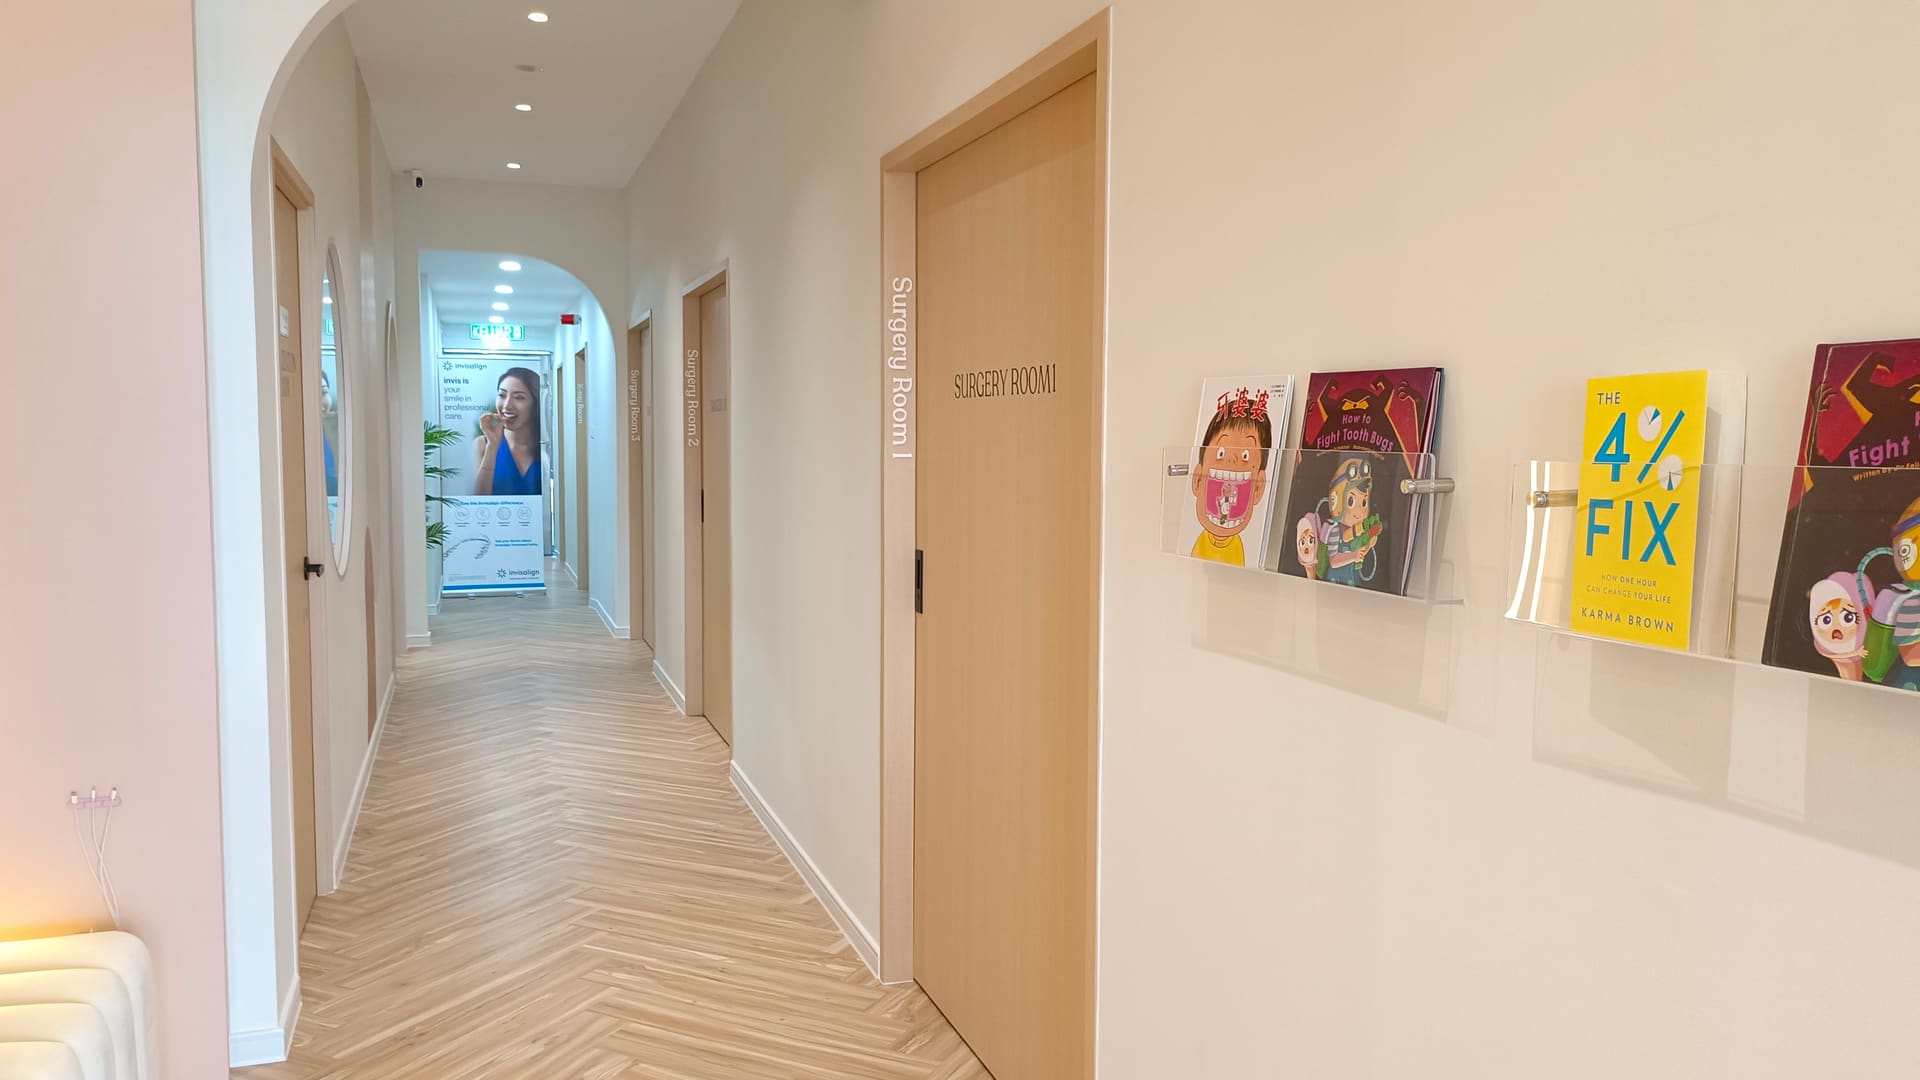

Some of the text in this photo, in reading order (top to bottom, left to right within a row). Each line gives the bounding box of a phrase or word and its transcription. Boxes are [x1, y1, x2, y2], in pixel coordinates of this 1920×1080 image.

[887, 277, 913, 370] Surgery
[454, 362, 488, 370] invisalign
[443, 376, 470, 385] invis is
[629, 369, 640, 406] Surgery
[954, 368, 1008, 399] SURGERY
[685, 349, 699, 447] Surgery Room 2
[1215, 385, 1270, 423] 牙婆婆
[1597, 391, 1621, 405] THE
[631, 407, 641, 433] Room
[892, 377, 913, 446] Room
[1342, 413, 1372, 425] How to
[1316, 429, 1341, 450] Fight
[1343, 428, 1369, 443] Tooth
[1369, 431, 1394, 452] Bugs
[1593, 406, 1686, 490] 4%
[1848, 435, 1911, 469] Fight
[1853, 469, 1881, 481] Written
[1585, 498, 1681, 566] FIX
[508, 568, 540, 577] invisalign
[1601, 574, 1657, 588] HOW ONE HOUR
[1586, 584, 1672, 605] CAN CHANGE YOUR LIFE
[1581, 607, 1674, 633] KARMA BROWN
